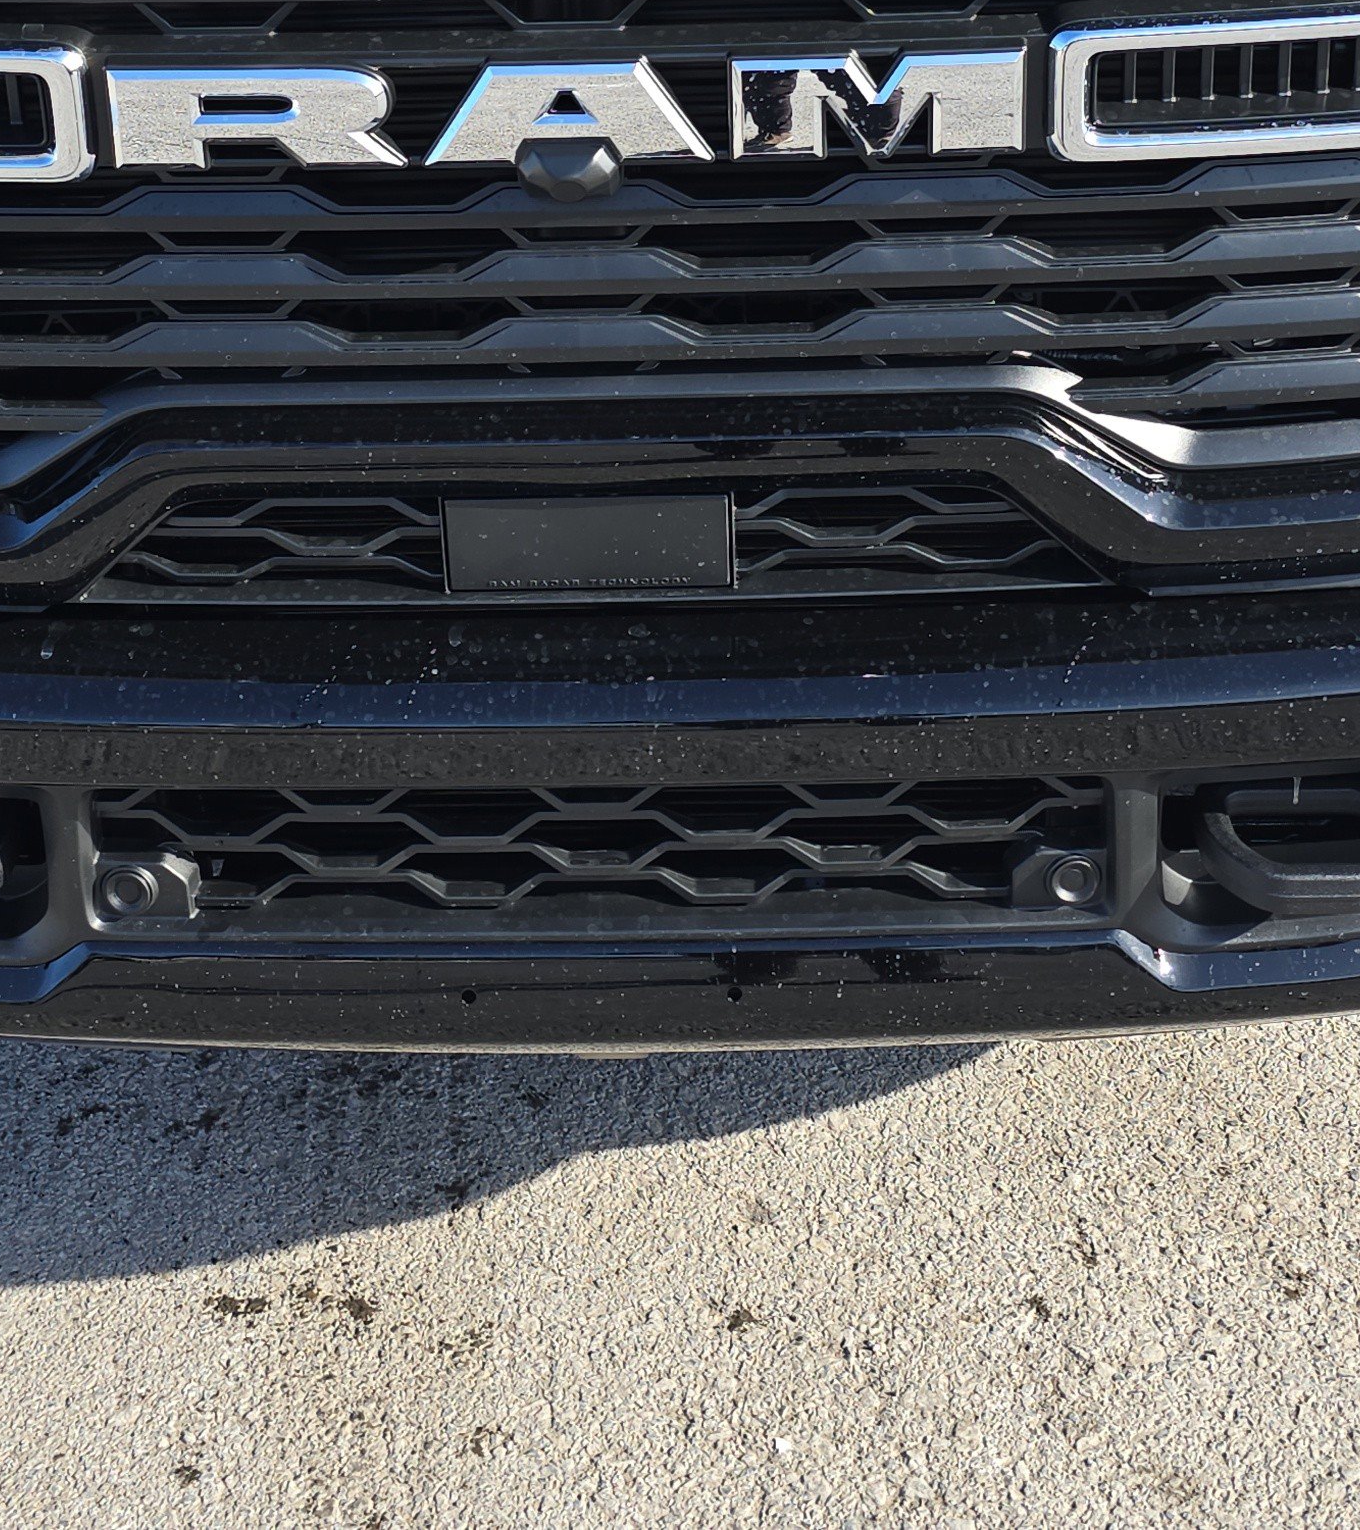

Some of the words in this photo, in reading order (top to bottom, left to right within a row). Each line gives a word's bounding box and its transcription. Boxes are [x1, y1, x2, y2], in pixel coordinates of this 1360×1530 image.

[104, 46, 1028, 170] RAM
[489, 579, 521, 587] RAM
[529, 579, 580, 587] RADAR
[589, 576, 691, 586] TECHNOLOGY
